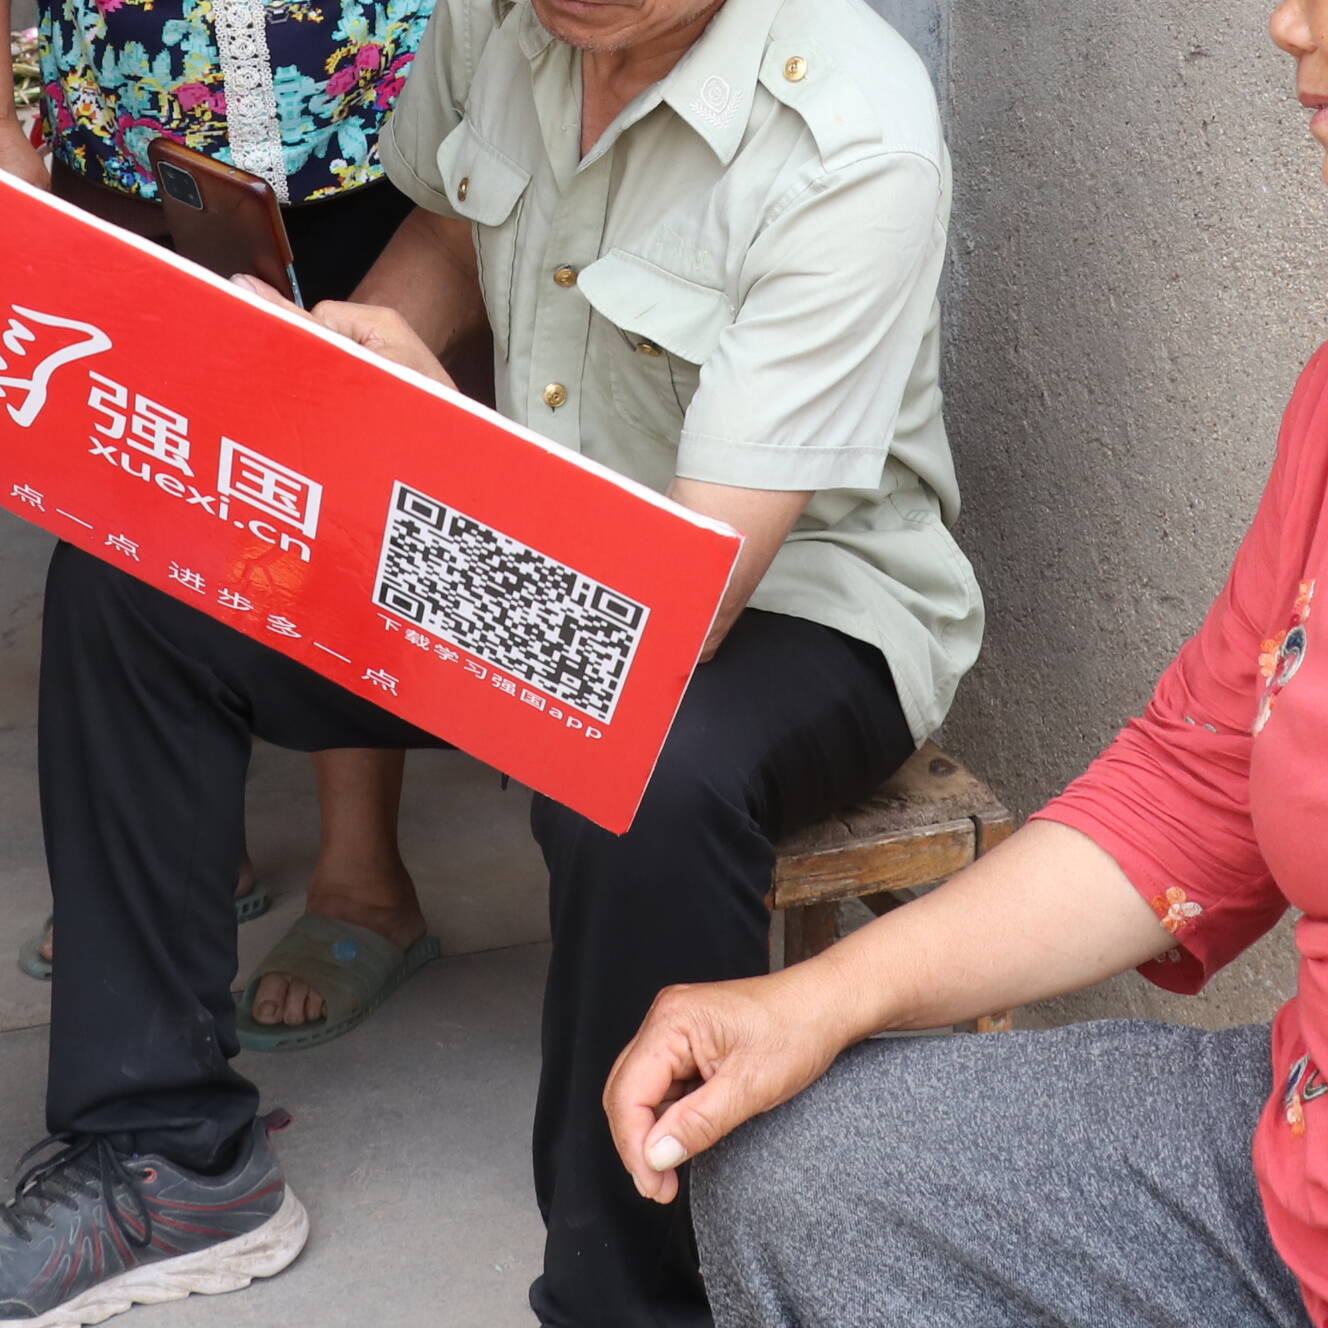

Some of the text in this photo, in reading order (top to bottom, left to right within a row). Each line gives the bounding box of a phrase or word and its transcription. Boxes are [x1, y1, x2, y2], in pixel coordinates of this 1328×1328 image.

[88, 435, 311, 562] xuexi.cn
[377, 612, 603, 739] 下载学习强国app
